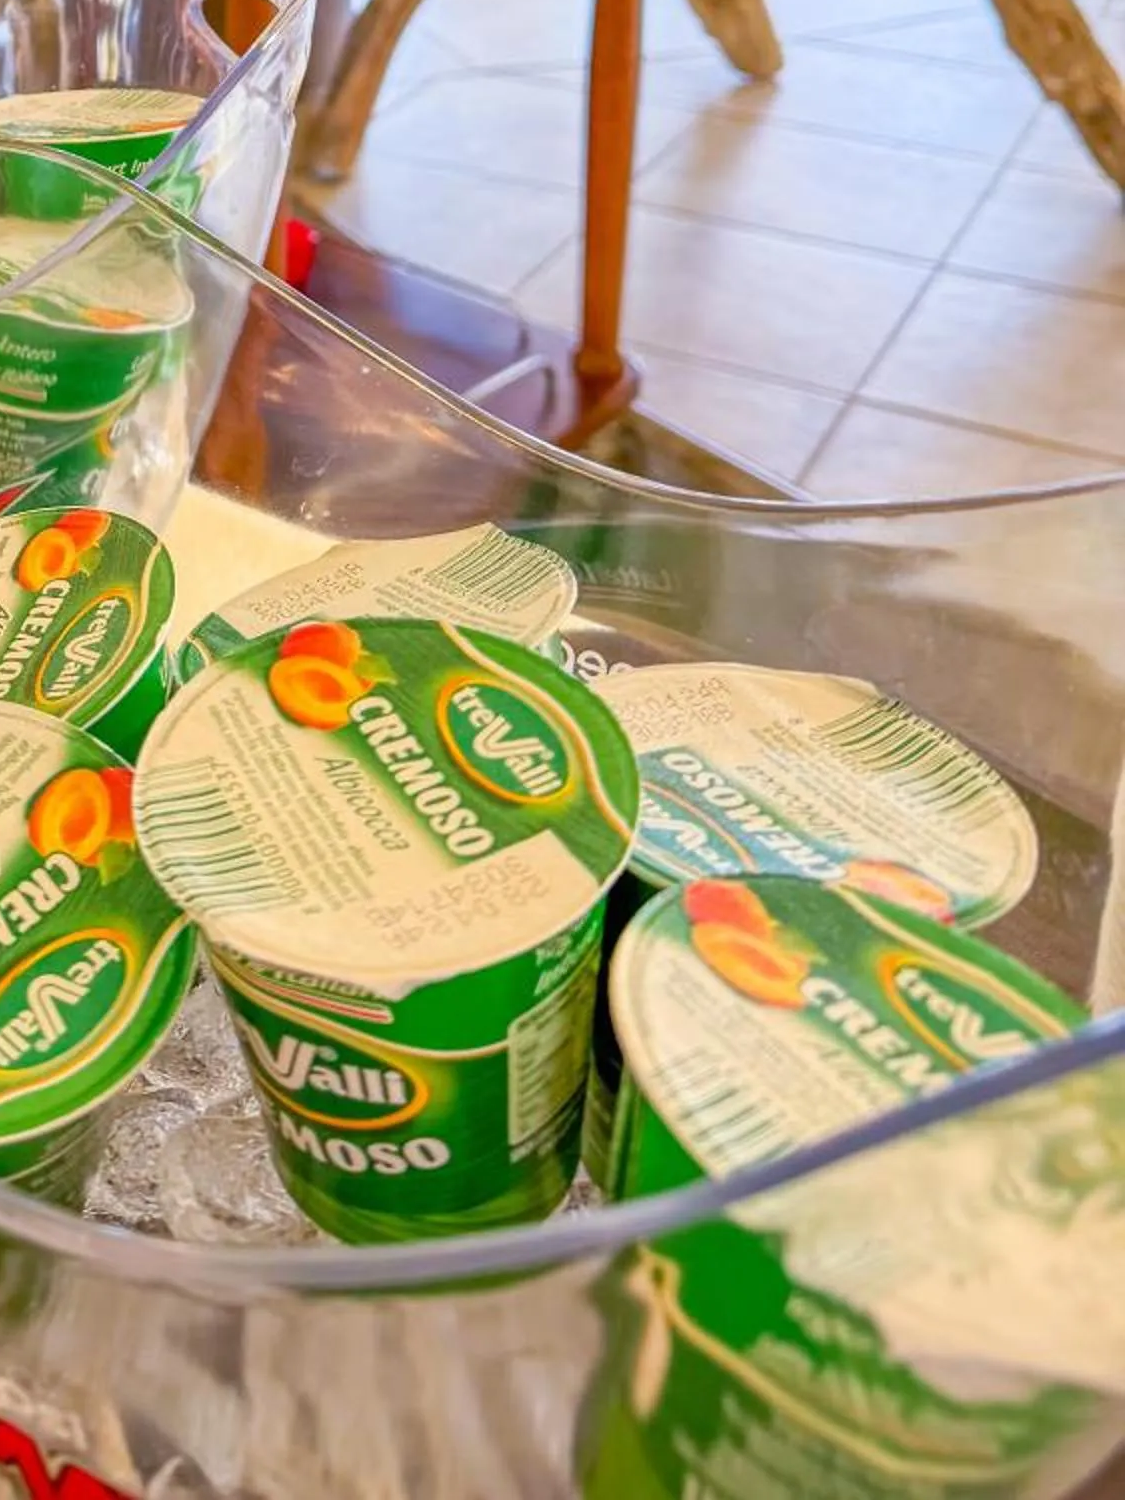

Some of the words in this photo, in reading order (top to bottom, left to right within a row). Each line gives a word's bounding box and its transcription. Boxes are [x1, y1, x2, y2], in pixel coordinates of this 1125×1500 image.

[43, 597, 122, 699] treValli
[346, 696, 495, 857] CREMOSO
[448, 683, 564, 795] treValli
[316, 756, 412, 852] Albicocca
[661, 752, 847, 880] CREMOSO
[251, 1027, 409, 1106] Valli
[800, 976, 954, 1097] CREM
[278, 1110, 451, 1175] MOSO
